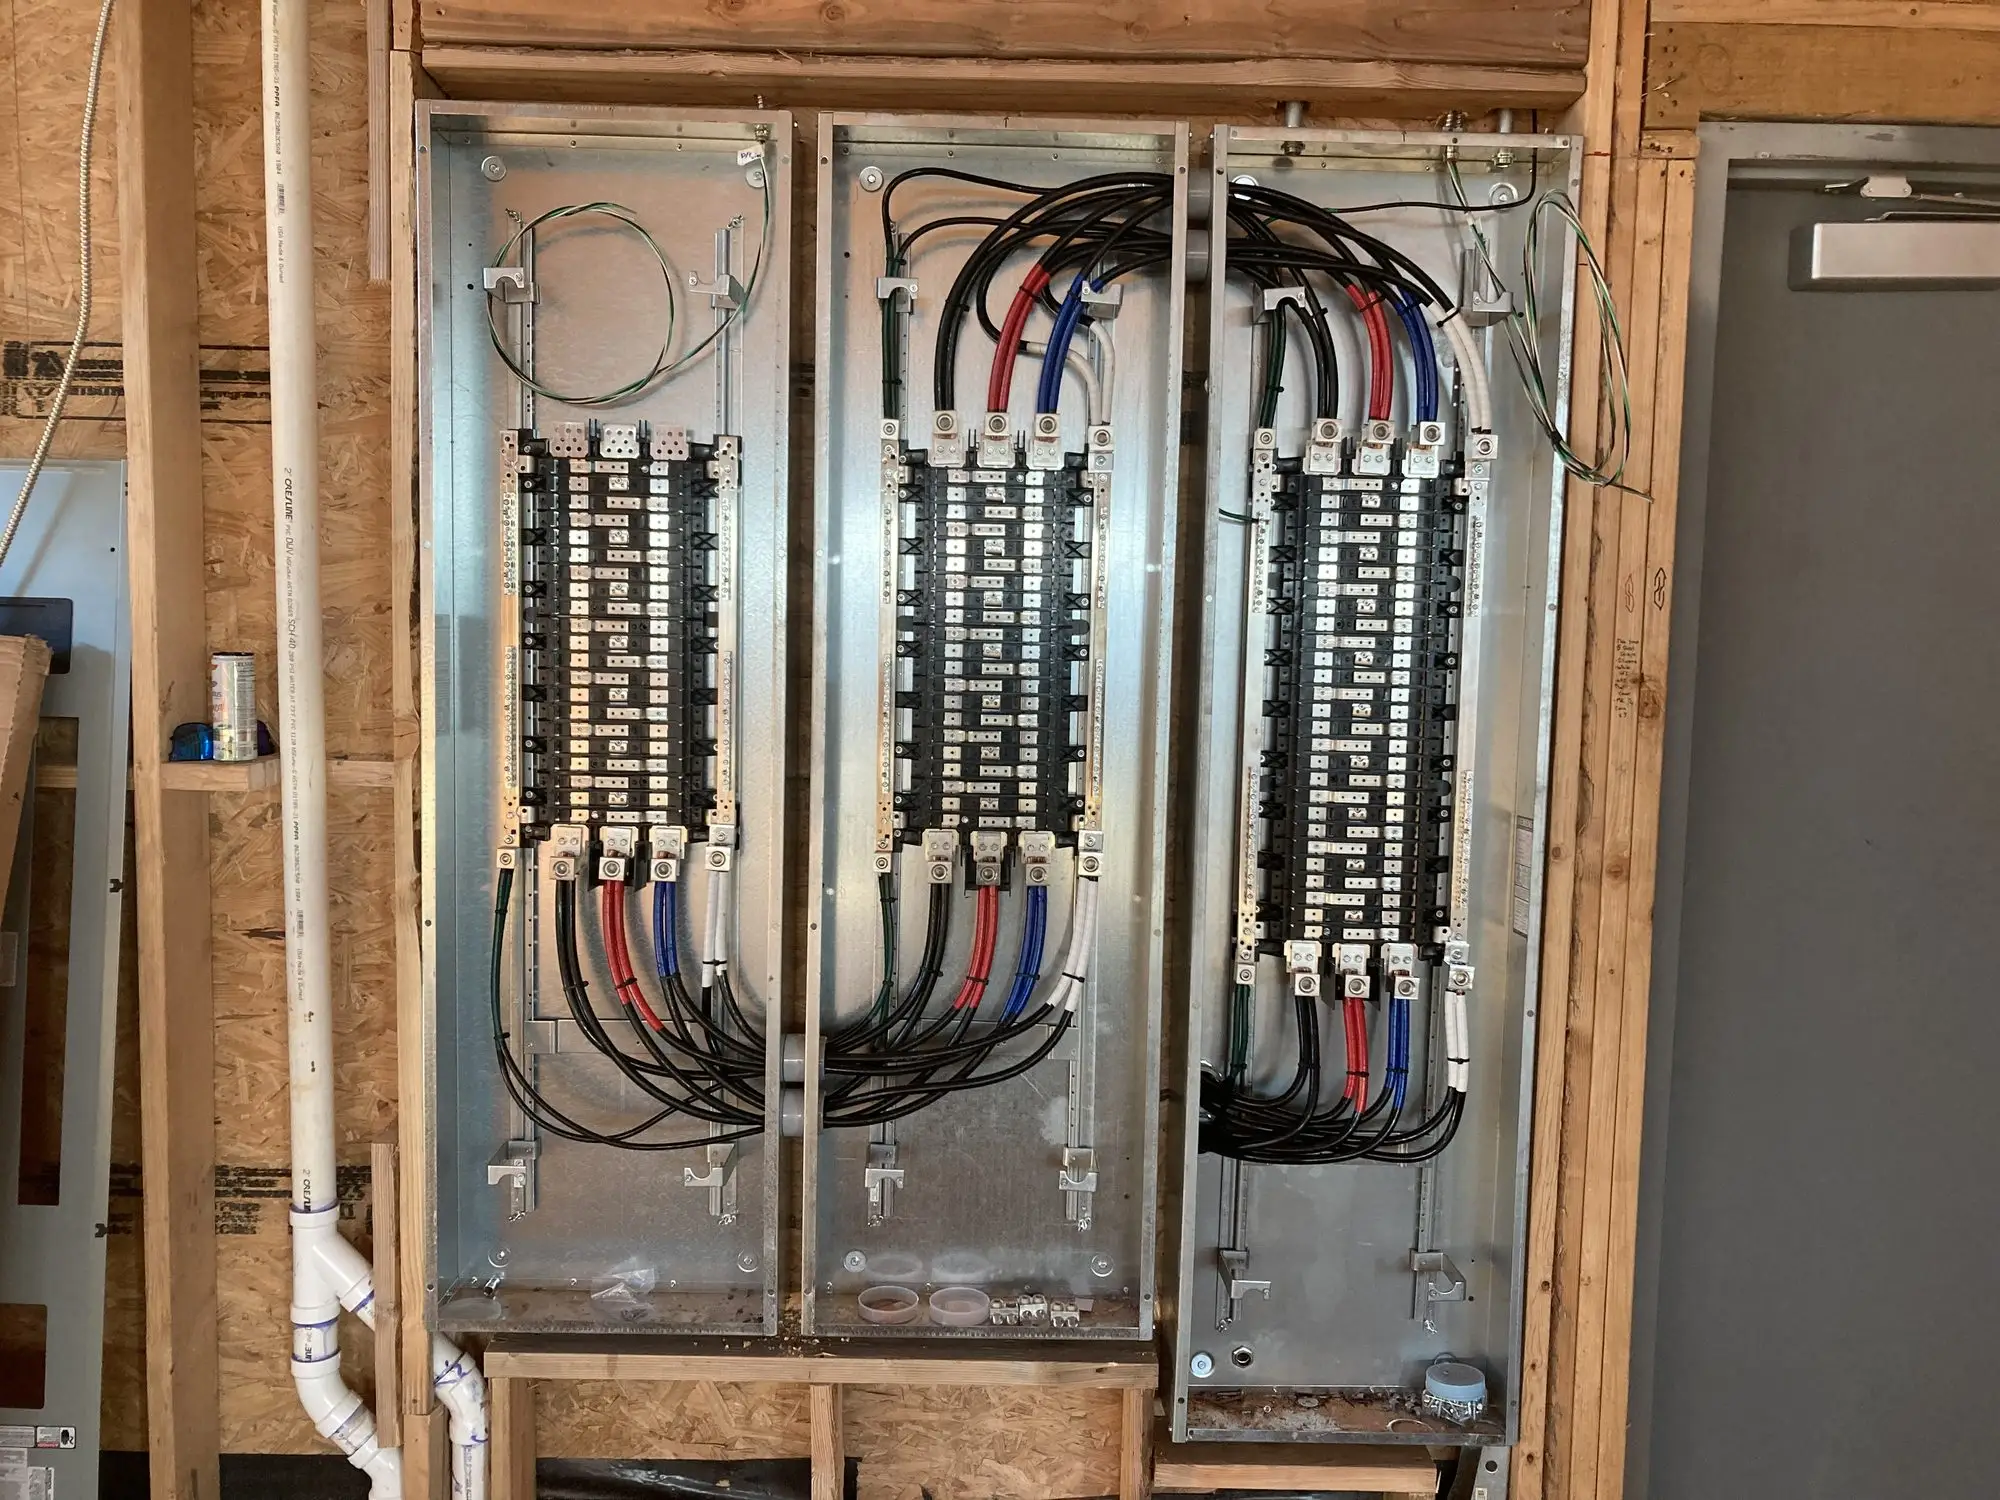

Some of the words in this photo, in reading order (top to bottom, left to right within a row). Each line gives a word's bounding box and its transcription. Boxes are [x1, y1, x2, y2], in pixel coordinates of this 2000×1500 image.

[285, 479, 293, 520] CRESLINE
[286, 537, 294, 555] DWV
[288, 619, 296, 635] SCH
[289, 638, 296, 649] 40
